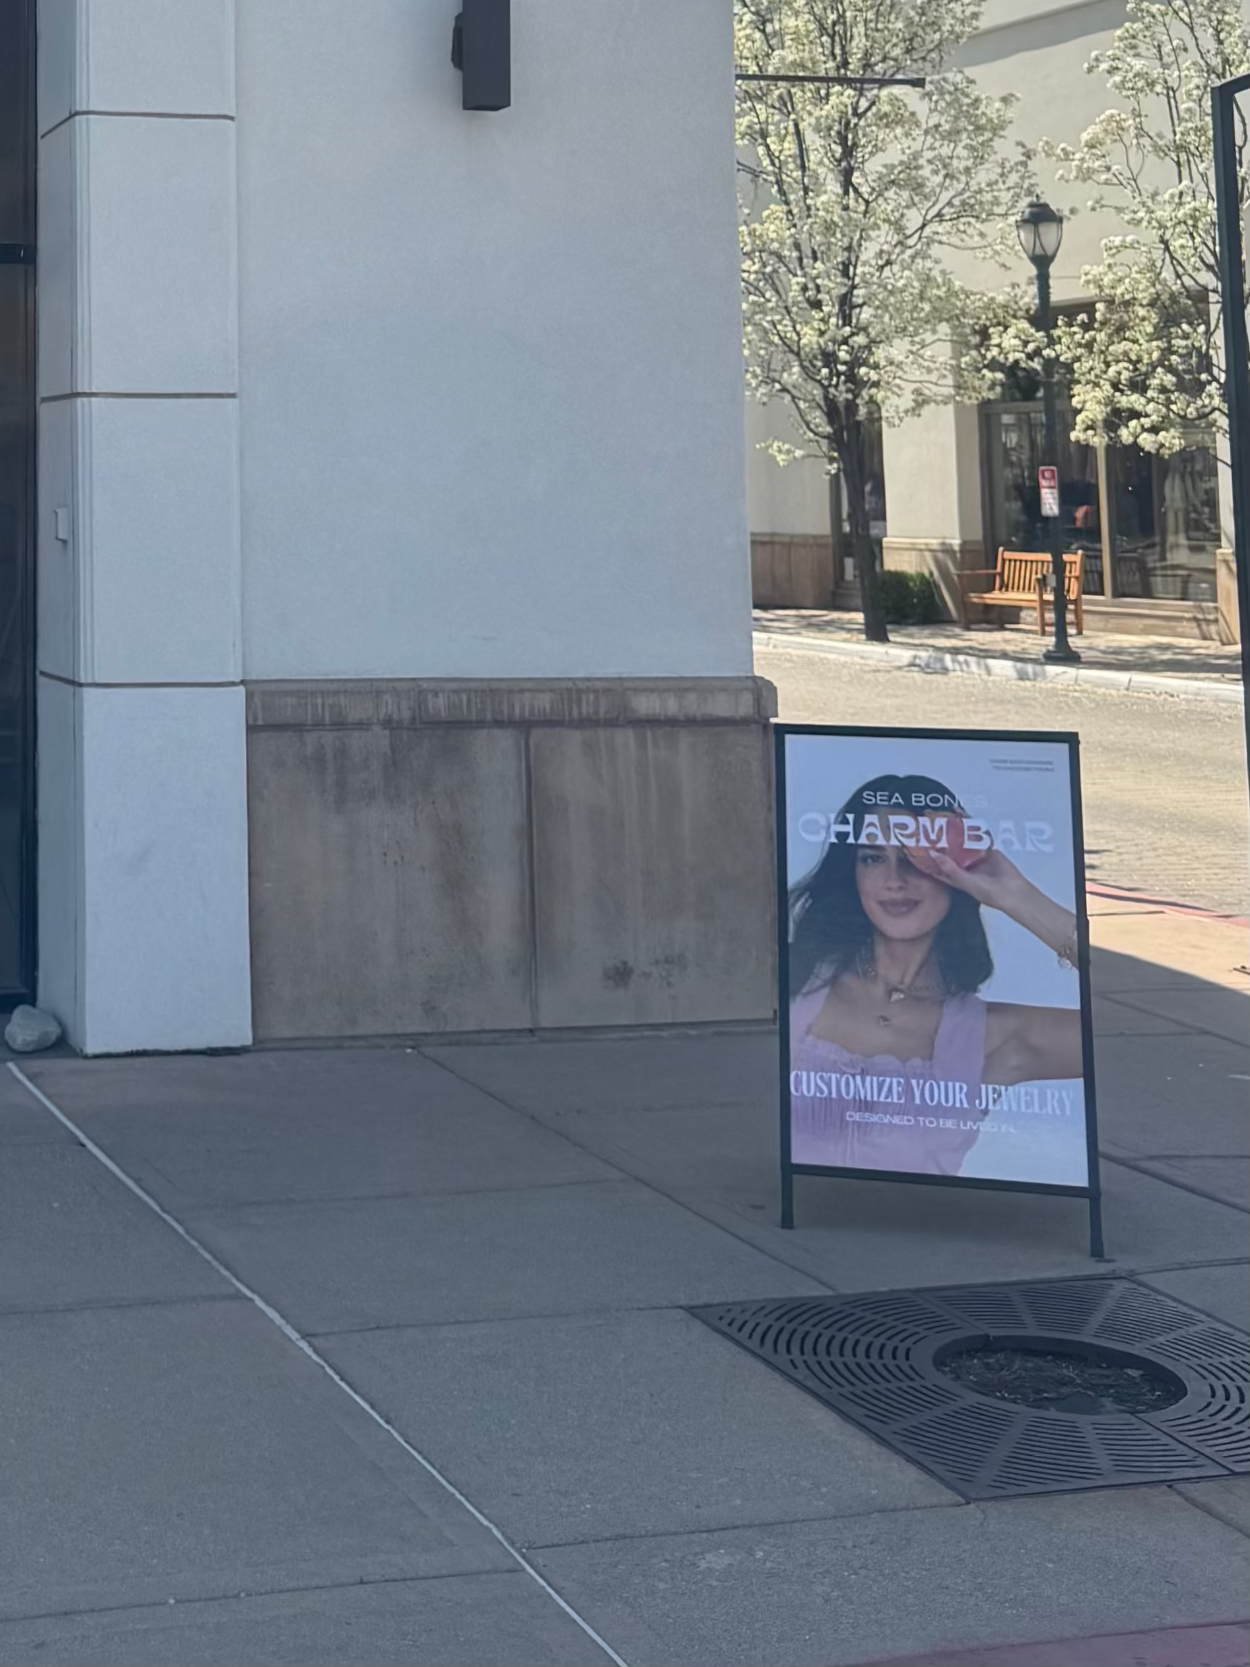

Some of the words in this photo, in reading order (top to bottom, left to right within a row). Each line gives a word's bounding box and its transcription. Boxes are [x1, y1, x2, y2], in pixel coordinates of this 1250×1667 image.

[862, 791, 905, 806] SEA
[798, 811, 950, 849] CHARM
[962, 817, 1054, 853] BAR
[790, 1070, 905, 1104] CUSTOMIZE
[910, 1078, 969, 1109] YOUR
[975, 1083, 1076, 1116] JEWELRY
[845, 1111, 914, 1126] DESIGNED
[917, 1116, 937, 1128] TO
[939, 1118, 958, 1130] BE
